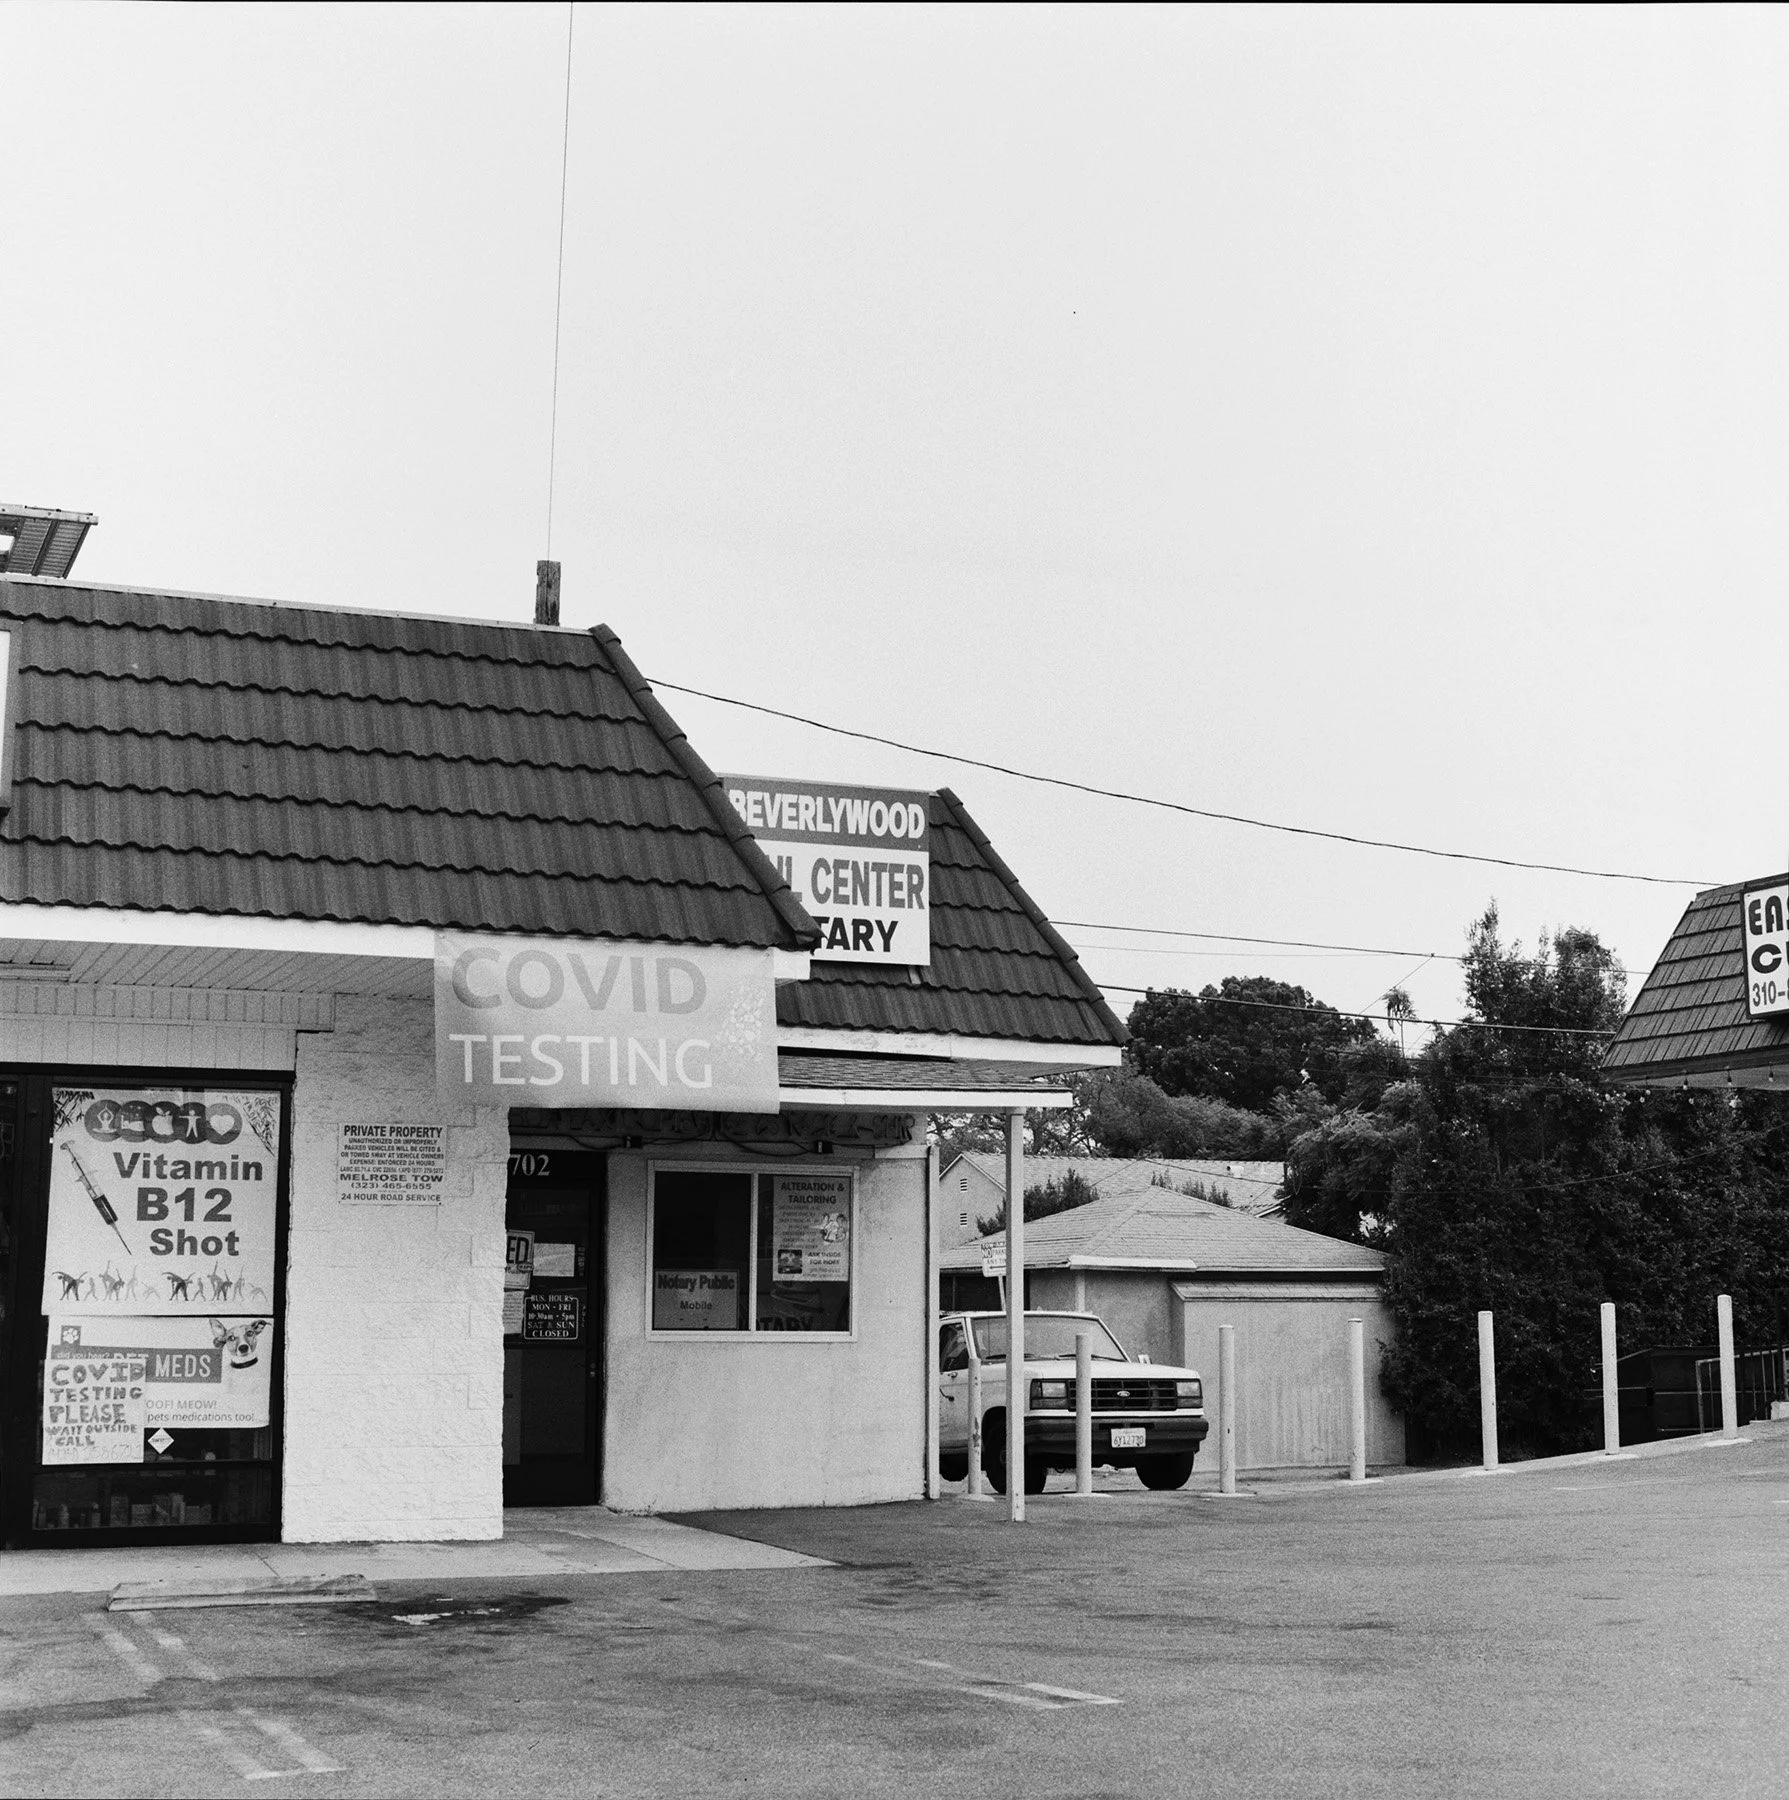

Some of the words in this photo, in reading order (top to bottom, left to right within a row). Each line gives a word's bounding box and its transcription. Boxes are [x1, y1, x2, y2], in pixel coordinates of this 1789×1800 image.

[728, 789, 926, 839] BEVERLYWOOD
[811, 857, 925, 910] CENTER
[1748, 895, 1789, 936] EA
[1751, 942, 1789, 974] C
[451, 947, 707, 1015] COVID
[1752, 978, 1789, 1007] 310-
[449, 1034, 713, 1089] TESTING
[344, 1125, 387, 1137] PRIVATE
[389, 1126, 443, 1138] PROPERTY
[113, 1152, 263, 1181] Vitamin
[340, 1173, 408, 1182] MELROSE
[411, 1174, 443, 1183] TOW
[382, 1182, 432, 1190] 465-6555
[781, 1182, 835, 1191] ALTERATION
[837, 1183, 845, 1191] &
[136, 1187, 233, 1222] B12
[353, 1193, 378, 1201] HOUR
[380, 1193, 404, 1201] ROAD
[405, 1194, 441, 1202] SERVICE
[788, 1195, 837, 1204] TAILORING
[149, 1228, 240, 1256] Shot
[657, 1274, 697, 1292] Notary
[699, 1274, 735, 1289] Public
[680, 1301, 713, 1310] Mobile
[556, 1321, 575, 1329] SUN
[561, 1312, 575, 1321] 5pm
[532, 1329, 569, 1337] CLOSED
[51, 1362, 145, 1386] COVID
[155, 1354, 212, 1378] MEDS
[49, 1386, 143, 1403] TESTING
[49, 1403, 126, 1424] PLEASE
[177, 1400, 217, 1410] MEOW!
[147, 1413, 169, 1423] pets
[172, 1412, 232, 1421] medications
[235, 1412, 255, 1421] too!
[45, 1425, 83, 1435] WAIT
[85, 1423, 137, 1434] OUTSIDE
[55, 1435, 95, 1447] CALL
